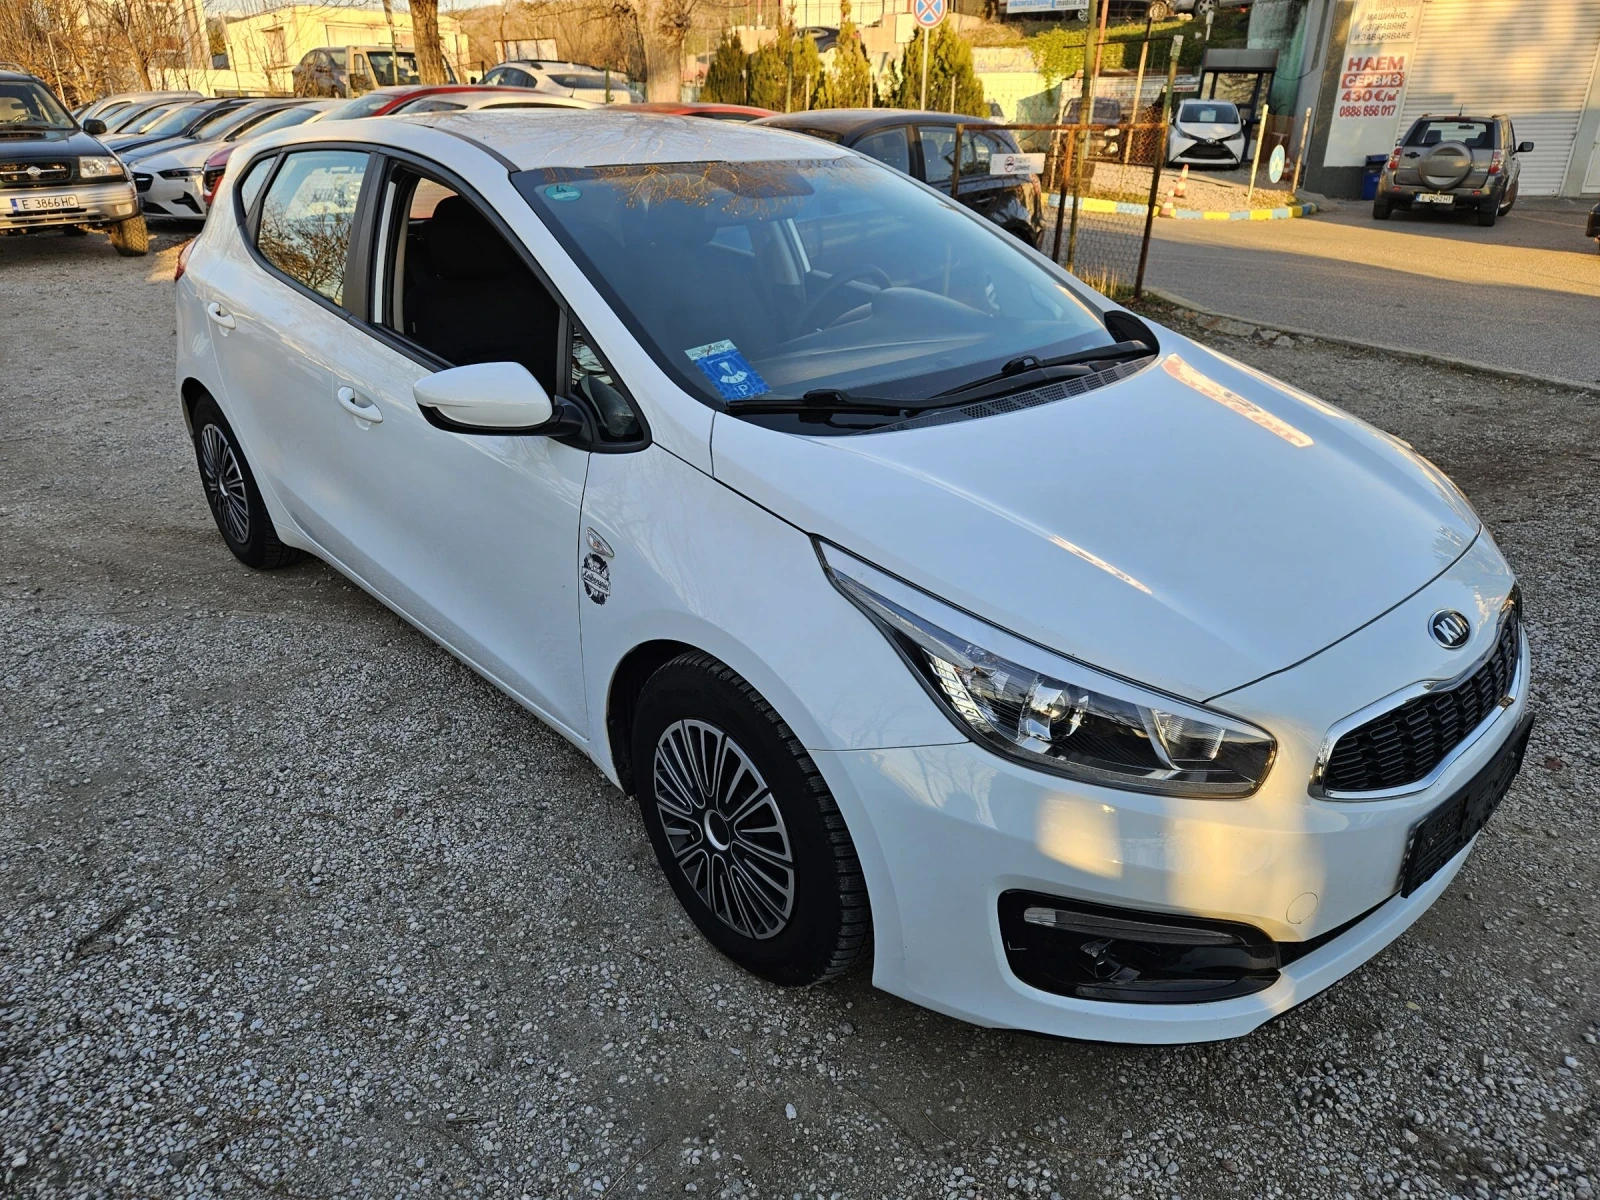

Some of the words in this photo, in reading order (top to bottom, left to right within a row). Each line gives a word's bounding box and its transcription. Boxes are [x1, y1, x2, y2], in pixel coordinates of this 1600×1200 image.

[1348, 56, 1404, 71] НАЕМ
[1345, 74, 1401, 87] СЕРВИЗ
[1342, 90, 1373, 102] 430
[1381, 104, 1397, 116] 017
[22, 199, 30, 209] E
[35, 197, 75, 208] 3866HC
